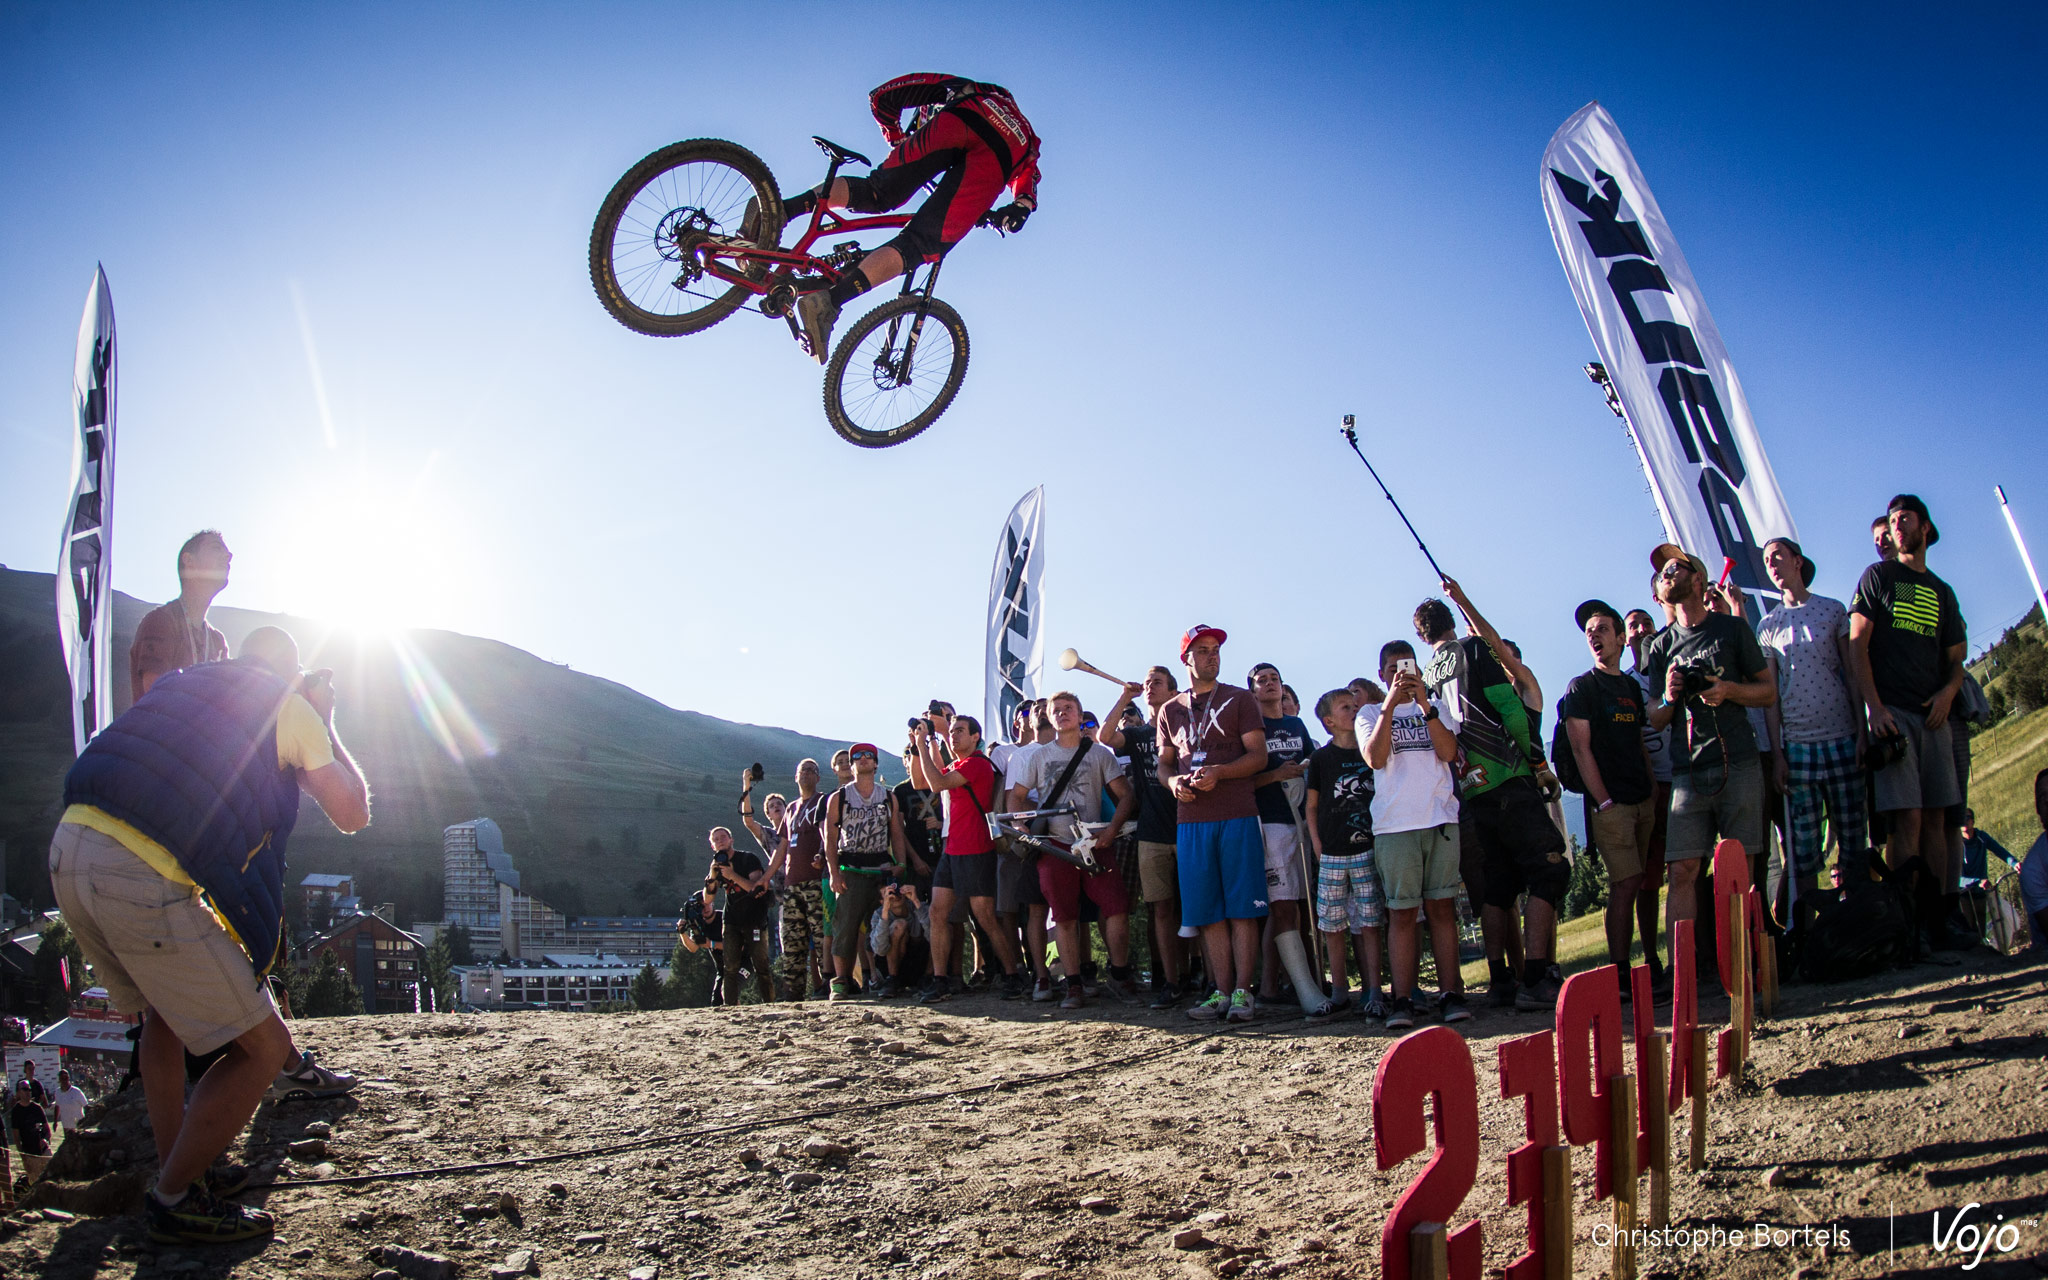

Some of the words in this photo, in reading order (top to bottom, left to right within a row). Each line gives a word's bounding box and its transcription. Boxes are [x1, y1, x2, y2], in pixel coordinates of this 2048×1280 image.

[988, 114, 1011, 136] DIGGA
[1550, 167, 1782, 630] PANK
[1136, 741, 1156, 753] SUR
[1267, 739, 1303, 751] PETROL
[846, 818, 876, 839] BIKE
[73, 1029, 127, 1042] SR
